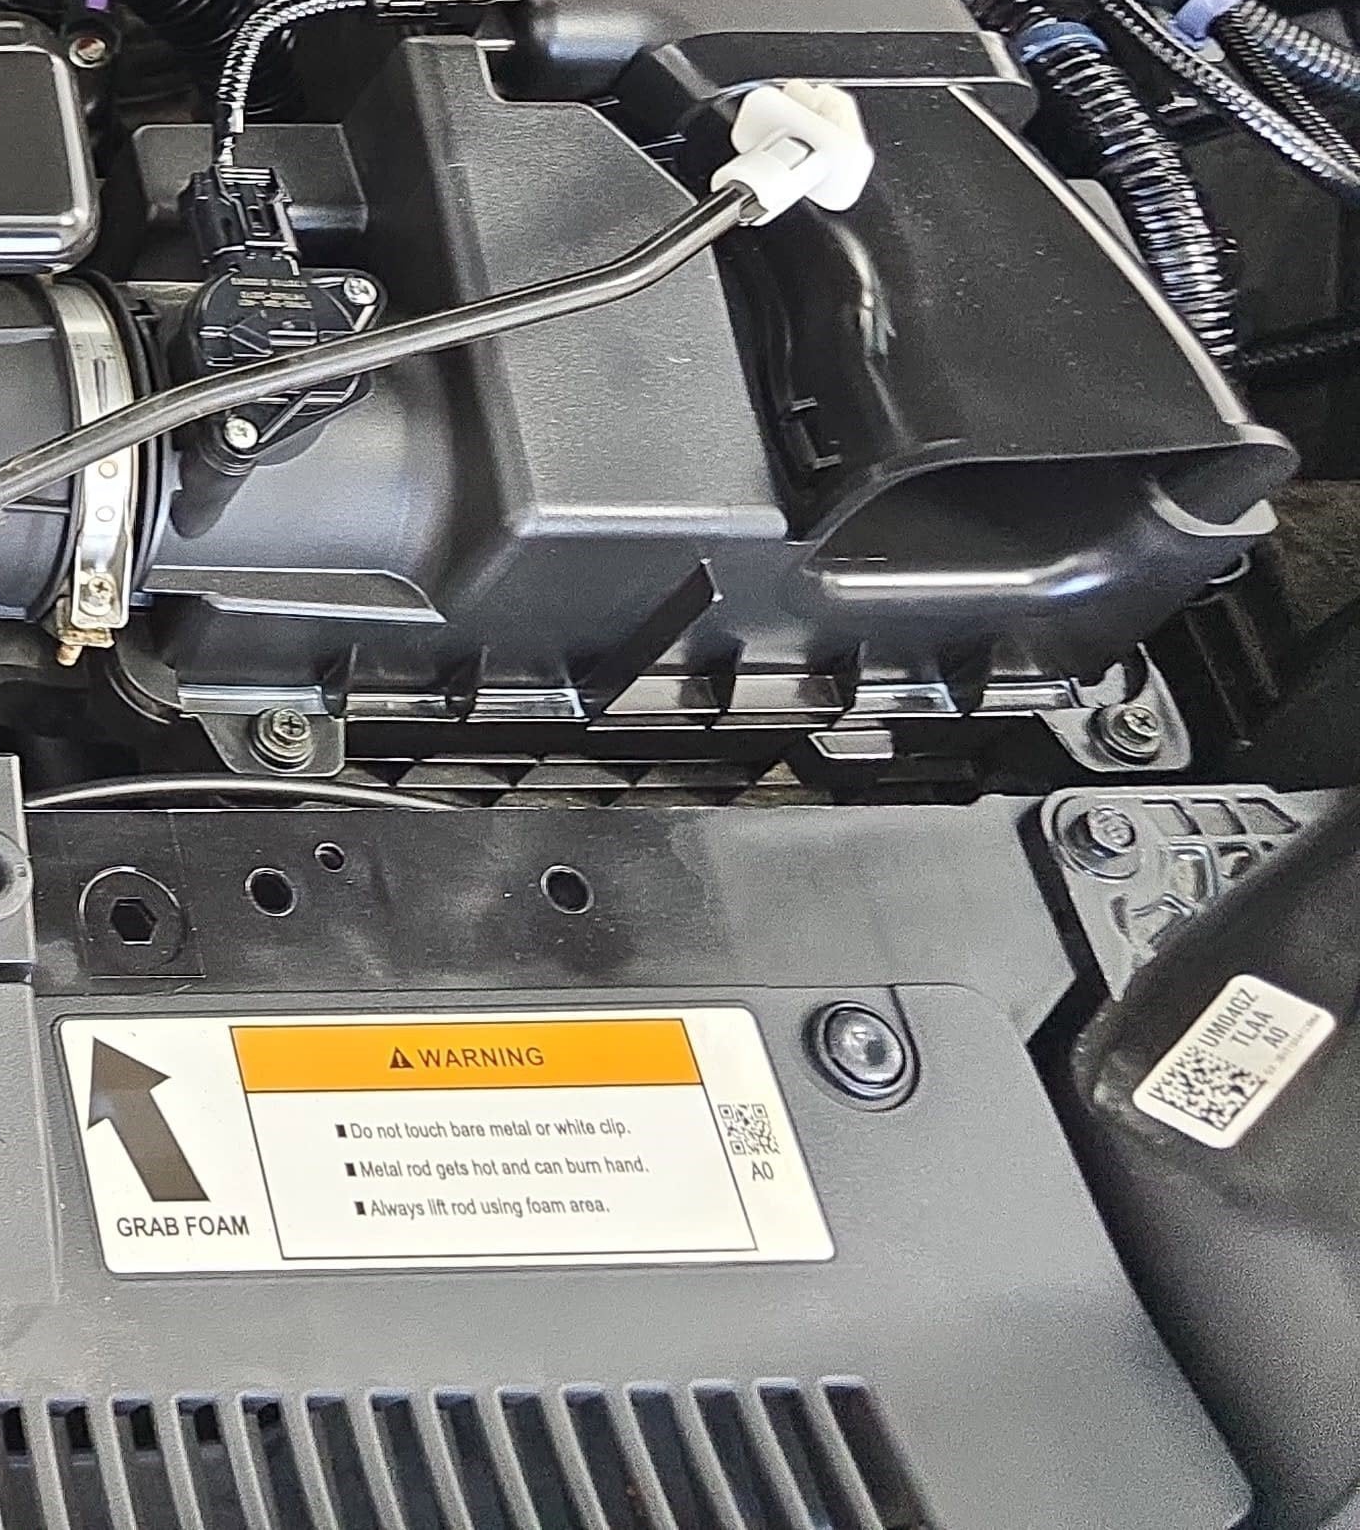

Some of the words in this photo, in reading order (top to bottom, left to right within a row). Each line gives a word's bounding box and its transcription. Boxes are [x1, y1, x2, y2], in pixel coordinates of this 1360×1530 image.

[1197, 987, 1259, 1048] UM04GZ
[1231, 1010, 1274, 1047] TLAA
[417, 1046, 544, 1068] WARNING
[350, 1122, 373, 1139] Do
[377, 1122, 402, 1139] not
[404, 1121, 448, 1138] touch
[450, 1121, 486, 1137] bare
[490, 1120, 532, 1136] metal
[535, 1122, 551, 1136] or
[553, 1118, 596, 1135] white
[599, 1118, 631, 1138] clip.
[359, 1161, 403, 1177] Metal
[406, 1159, 432, 1176] rod
[435, 1160, 469, 1180] gets
[472, 1159, 499, 1175] hot
[501, 1158, 531, 1175] and
[534, 1160, 563, 1174] can
[565, 1157, 601, 1173] burn
[603, 1155, 650, 1173] hand.
[371, 1200, 425, 1220] Always
[427, 1198, 449, 1215] lift
[451, 1198, 477, 1214] rod
[480, 1196, 523, 1218] using
[526, 1196, 566, 1213] foam
[569, 1198, 610, 1213] area.
[116, 1217, 180, 1237] GRAB
[184, 1215, 250, 1237] FOAM
